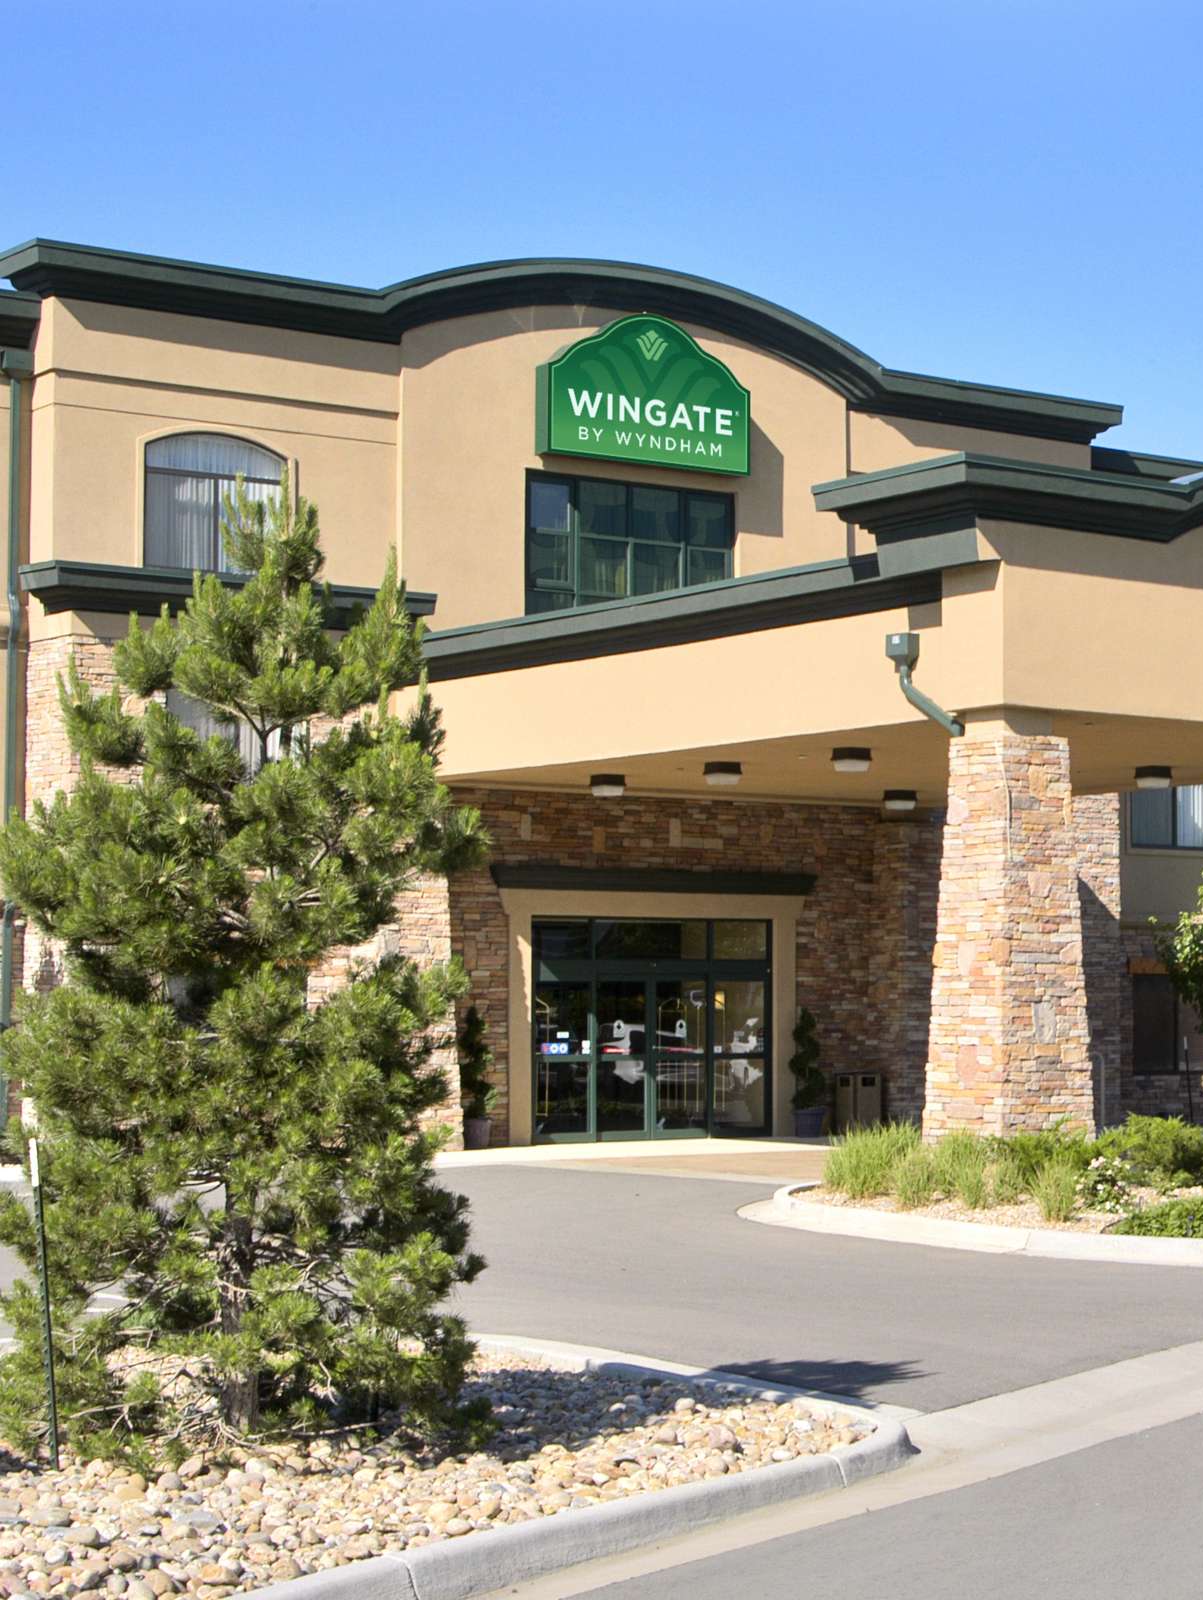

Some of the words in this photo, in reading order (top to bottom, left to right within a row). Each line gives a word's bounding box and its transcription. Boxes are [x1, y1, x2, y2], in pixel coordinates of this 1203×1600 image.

[568, 388, 733, 436] WINGATE
[578, 426, 603, 442] BY
[615, 431, 722, 457] WYNDHAM
